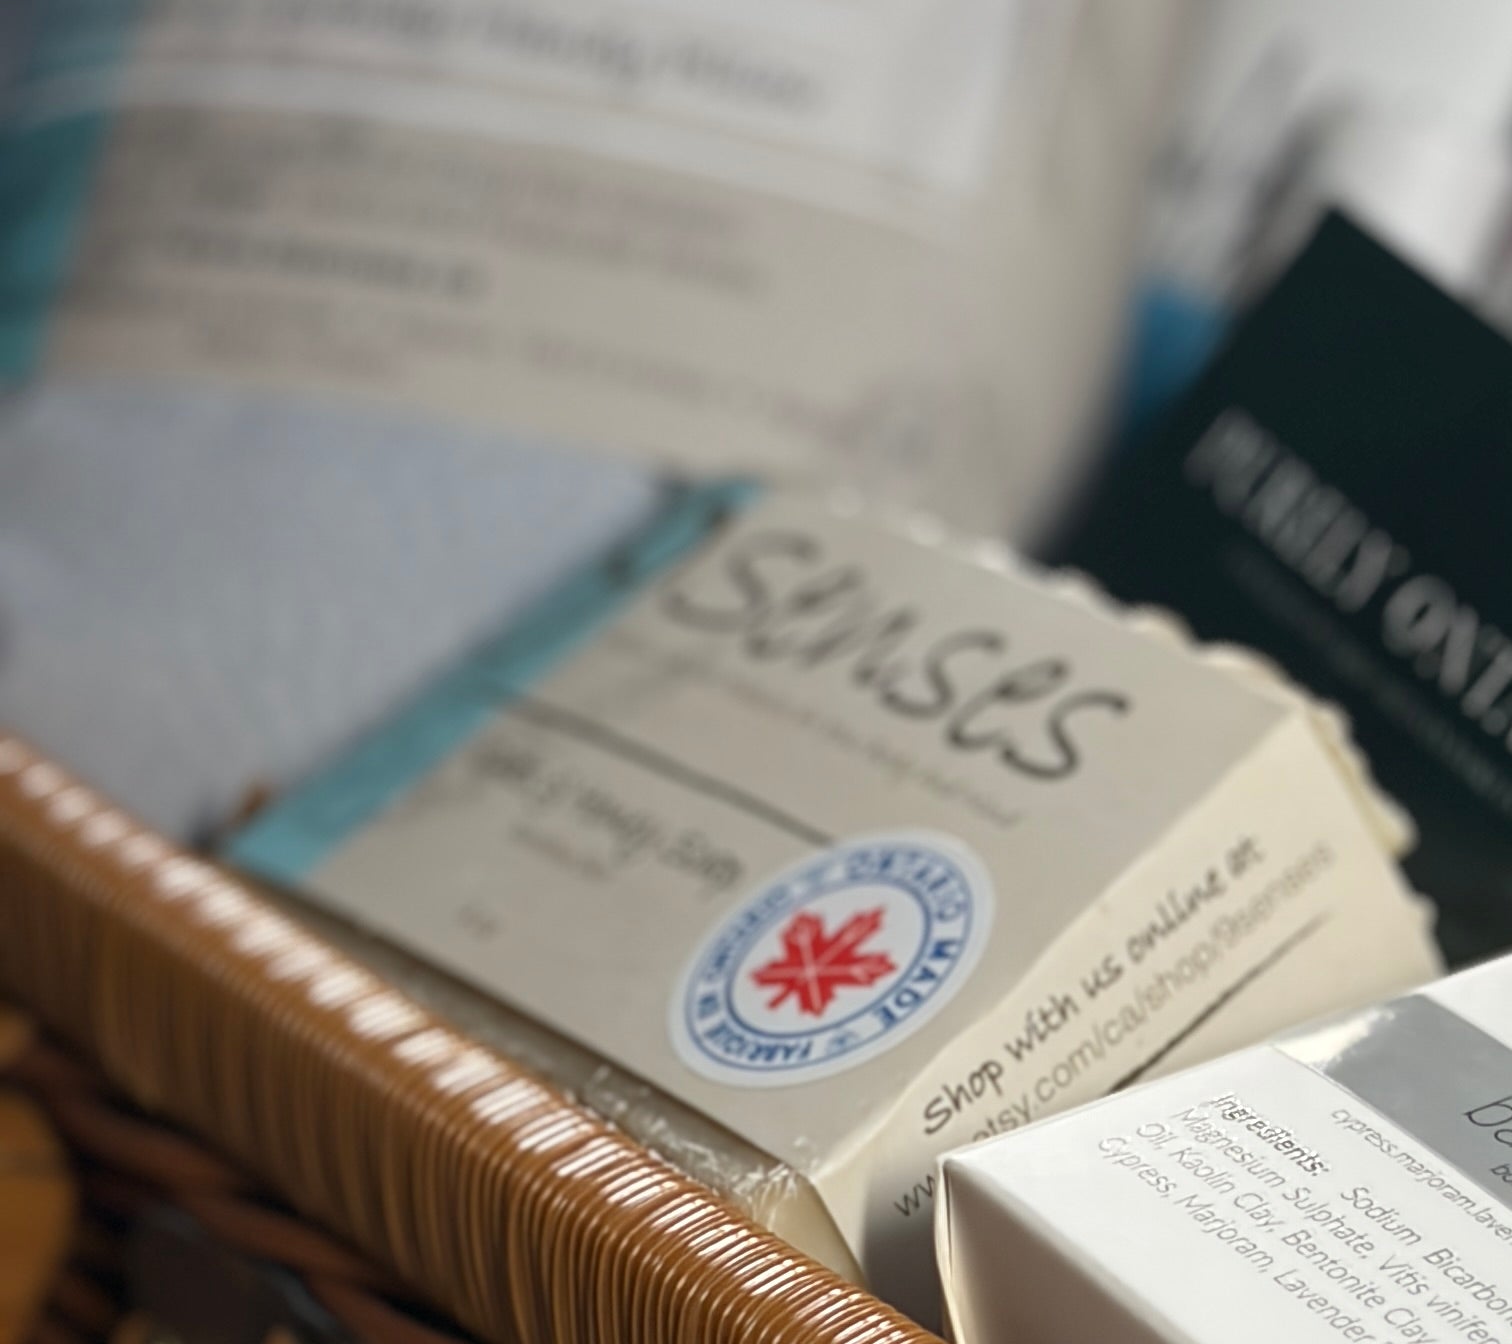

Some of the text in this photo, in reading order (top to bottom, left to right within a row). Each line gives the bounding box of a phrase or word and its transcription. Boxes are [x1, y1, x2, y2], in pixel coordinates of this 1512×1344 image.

[871, 936, 962, 1032] MADE
[923, 834, 1267, 1136] Shop with us online at
[1098, 1136, 1178, 1199] Cypress,
[1175, 1192, 1276, 1274] Marjoram,
[1272, 1267, 1377, 1344] Lavender
[1136, 1121, 1178, 1150] Oil,
[1168, 1145, 1237, 1196] Kaolin
[1233, 1190, 1286, 1234] Clay,
[1281, 1229, 1387, 1310] Bentonite
[1170, 1106, 1287, 1189] Magnesium
[1281, 1186, 1376, 1261] Sulphate,
[1379, 1253, 1430, 1297] Vitis
[1209, 1092, 1330, 1177] Ingredients:
[1340, 1185, 1423, 1248] Sodium
